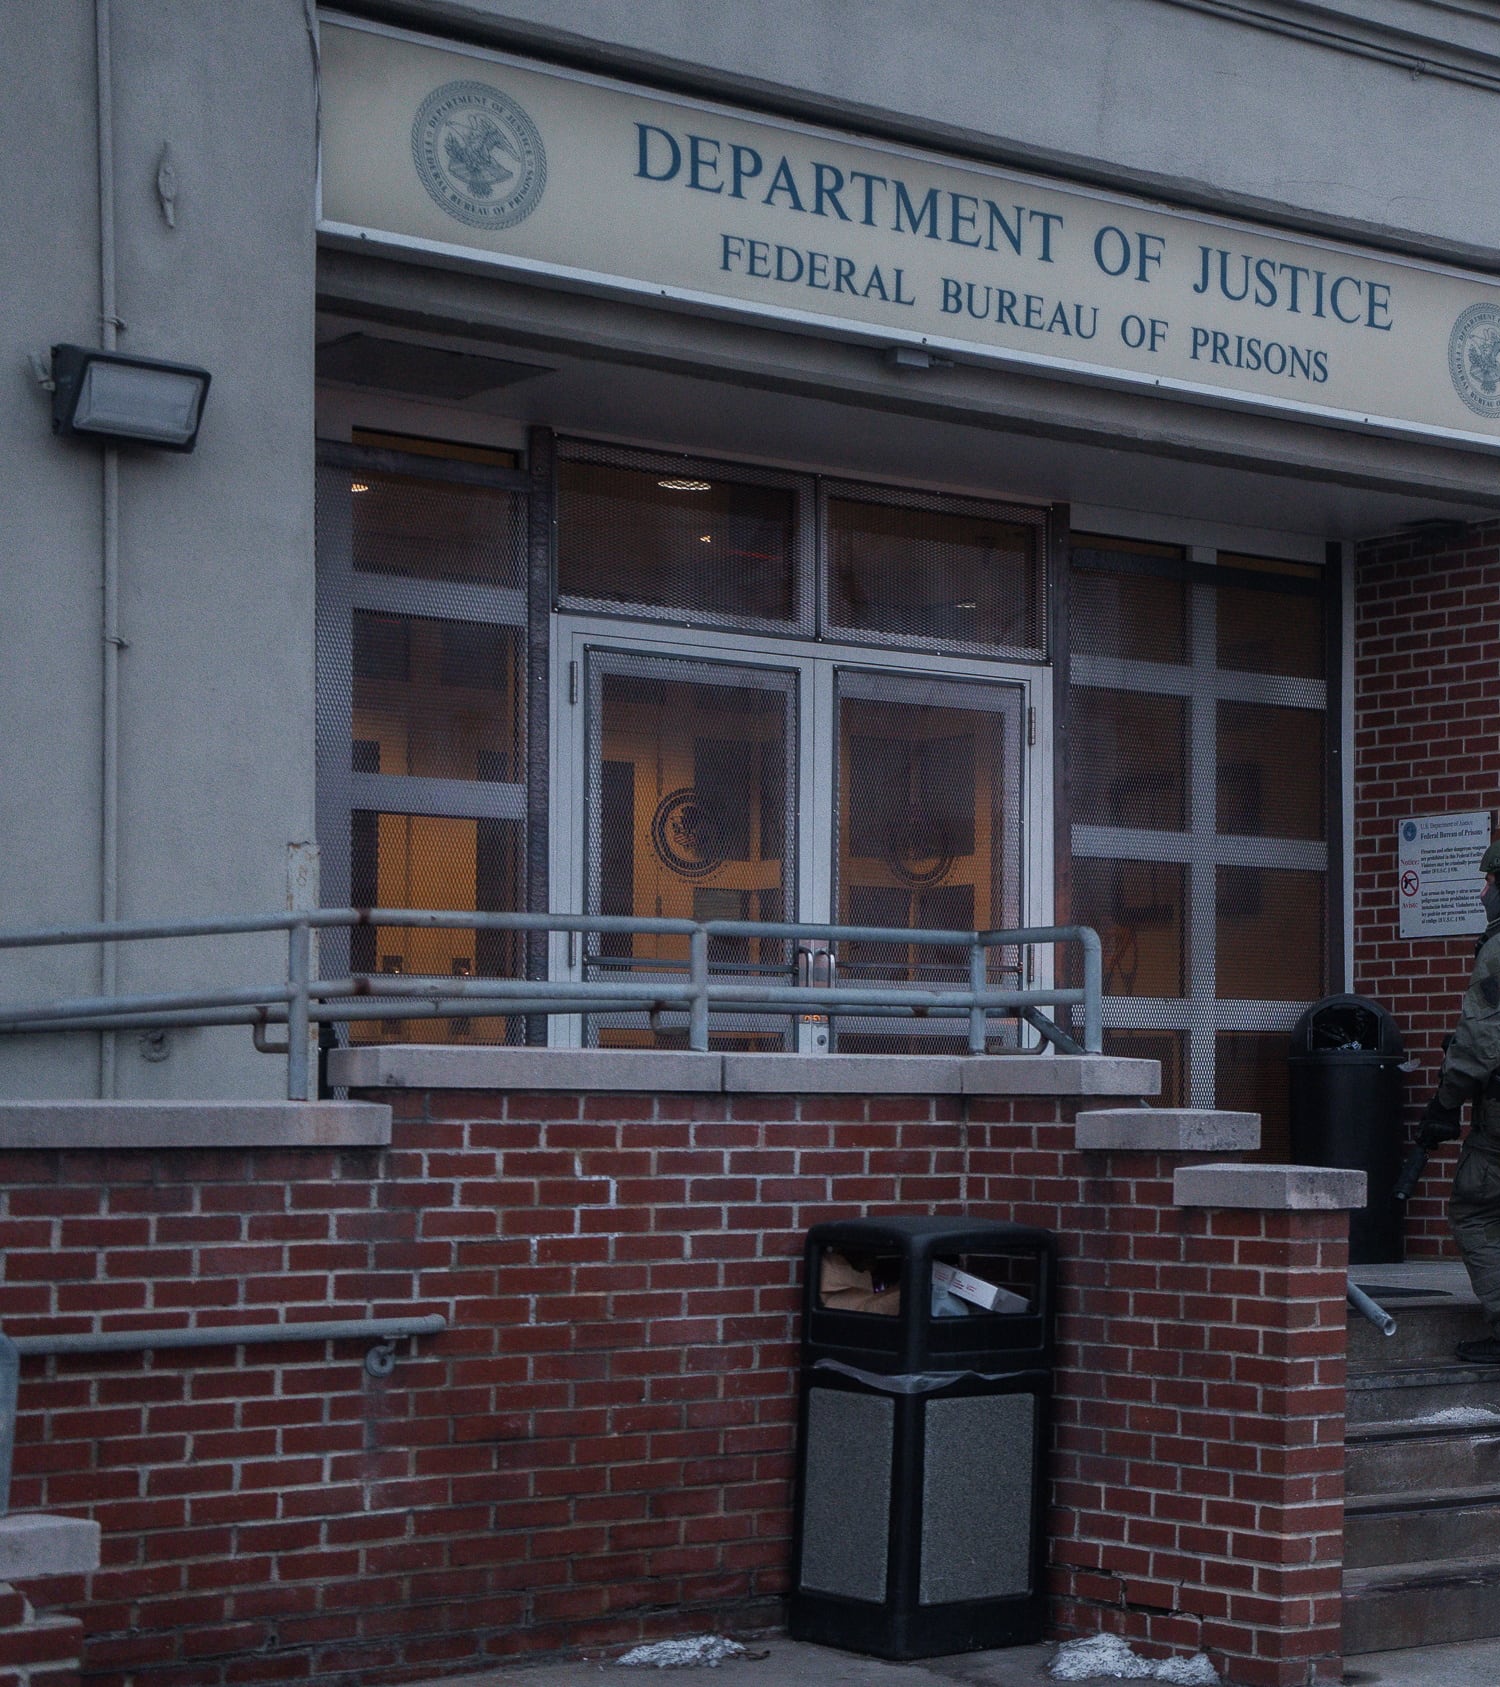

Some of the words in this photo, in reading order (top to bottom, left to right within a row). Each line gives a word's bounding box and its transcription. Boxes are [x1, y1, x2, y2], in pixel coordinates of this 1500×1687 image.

[428, 95, 487, 129] DEPARTMENT
[491, 101, 506, 114] OF
[504, 113, 534, 156] JUSTICE
[449, 191, 490, 216] BUREAU
[493, 207, 506, 217] OF
[508, 171, 535, 209] PRISONS
[632, 122, 1064, 264] DEPARTMENT
[1093, 225, 1167, 283] OF
[1192, 245, 1393, 332] JUSTICE
[719, 233, 916, 307] FEDERAL
[940, 277, 1100, 340] BUREAU
[1120, 314, 1169, 352] OF
[1189, 326, 1329, 383] PRISONS
[1420, 831, 1438, 840] Federal
[1439, 830, 1457, 839] Bureau
[1458, 829, 1464, 837] of
[1464, 828, 1483, 836] Prisons
